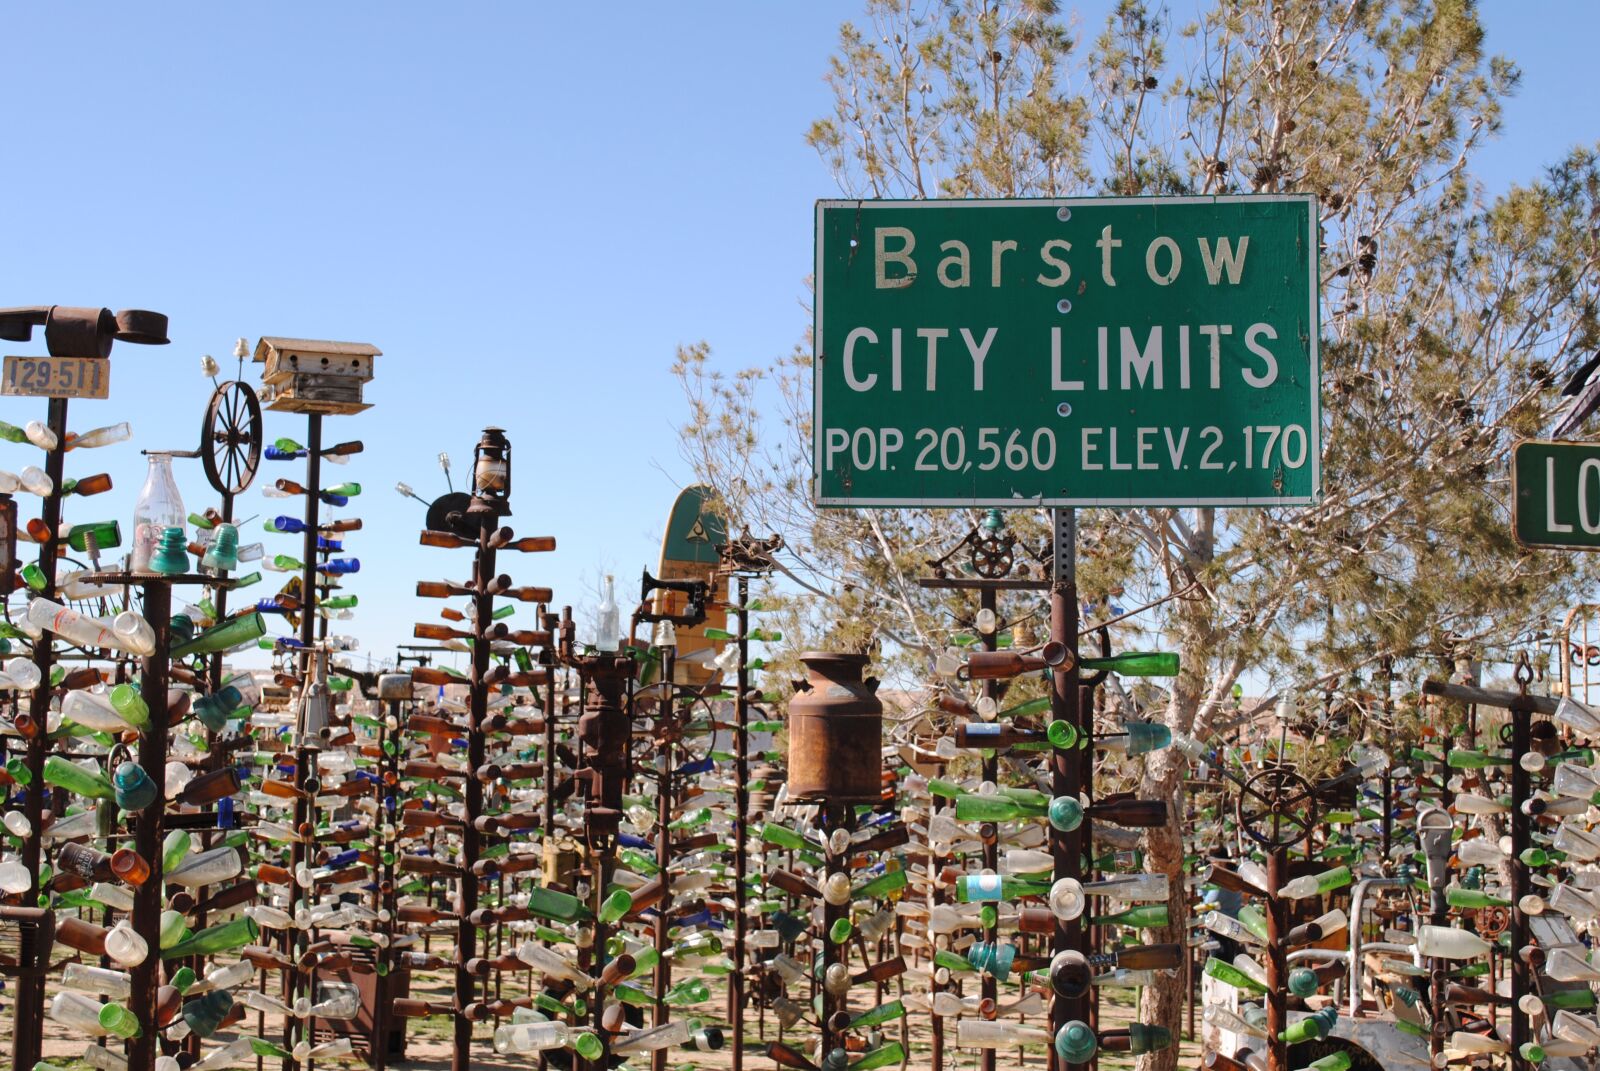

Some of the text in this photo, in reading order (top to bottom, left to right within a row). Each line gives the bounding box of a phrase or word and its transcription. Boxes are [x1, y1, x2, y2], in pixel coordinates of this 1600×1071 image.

[874, 224, 1250, 289] Barstow
[842, 322, 1279, 392] CITY LIMITS
[825, 424, 1308, 474] POP. 20,560 ELEV. 2,170
